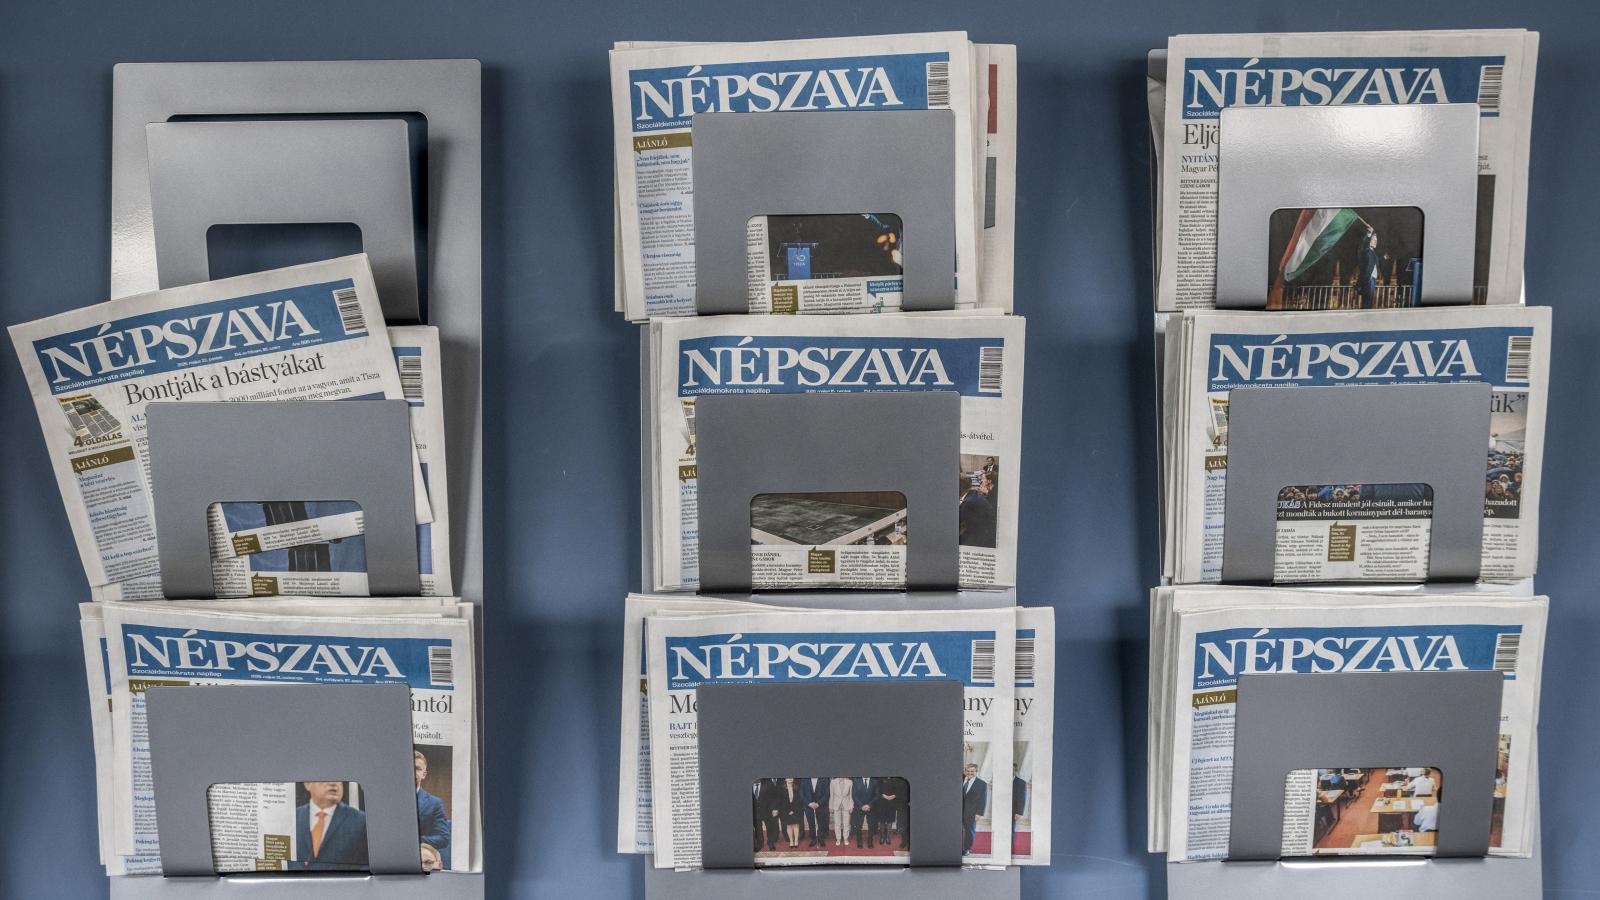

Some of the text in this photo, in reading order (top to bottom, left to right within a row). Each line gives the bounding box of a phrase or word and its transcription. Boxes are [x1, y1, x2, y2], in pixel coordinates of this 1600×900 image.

[634, 65, 904, 121] NÉPSZAVA
[1187, 58, 1451, 108] NÉPSZAVA
[636, 137, 668, 149] AJÁNLÓ
[1181, 165, 1208, 173] Magyar
[41, 299, 319, 384] NÉPSZAVA
[682, 336, 955, 387] NÉPSZAVA
[1211, 334, 1482, 381] NÉPSZAVA
[54, 368, 145, 394] Szociáldemokrata napilap
[123, 352, 327, 405] Bontják a bástyákat
[249, 390, 277, 401] milliárd
[278, 387, 297, 397] forint
[298, 385, 307, 393] az
[311, 380, 338, 392] vagyon,
[339, 376, 354, 385] amit
[361, 372, 380, 381] Tisza
[74, 435, 84, 447] 4
[84, 432, 123, 446] OLDALAS
[1212, 435, 1222, 447] 4
[686, 444, 695, 456] 4
[74, 455, 109, 470] AJÁNLÓ
[1286, 509, 1317, 517] mondták
[1346, 509, 1391, 518] kormánypárt
[1372, 500, 1396, 508] csinált,
[1485, 499, 1517, 507] hazudott
[127, 628, 407, 678] NÉPSZAVA
[670, 633, 947, 680] NÉPSZAVA
[1198, 628, 1469, 679] NÉPSZAVA
[1194, 693, 1226, 705] AJÁNLÓ
[669, 720, 984, 730] RAJT Nem
[414, 731, 443, 740] lapátolt.
